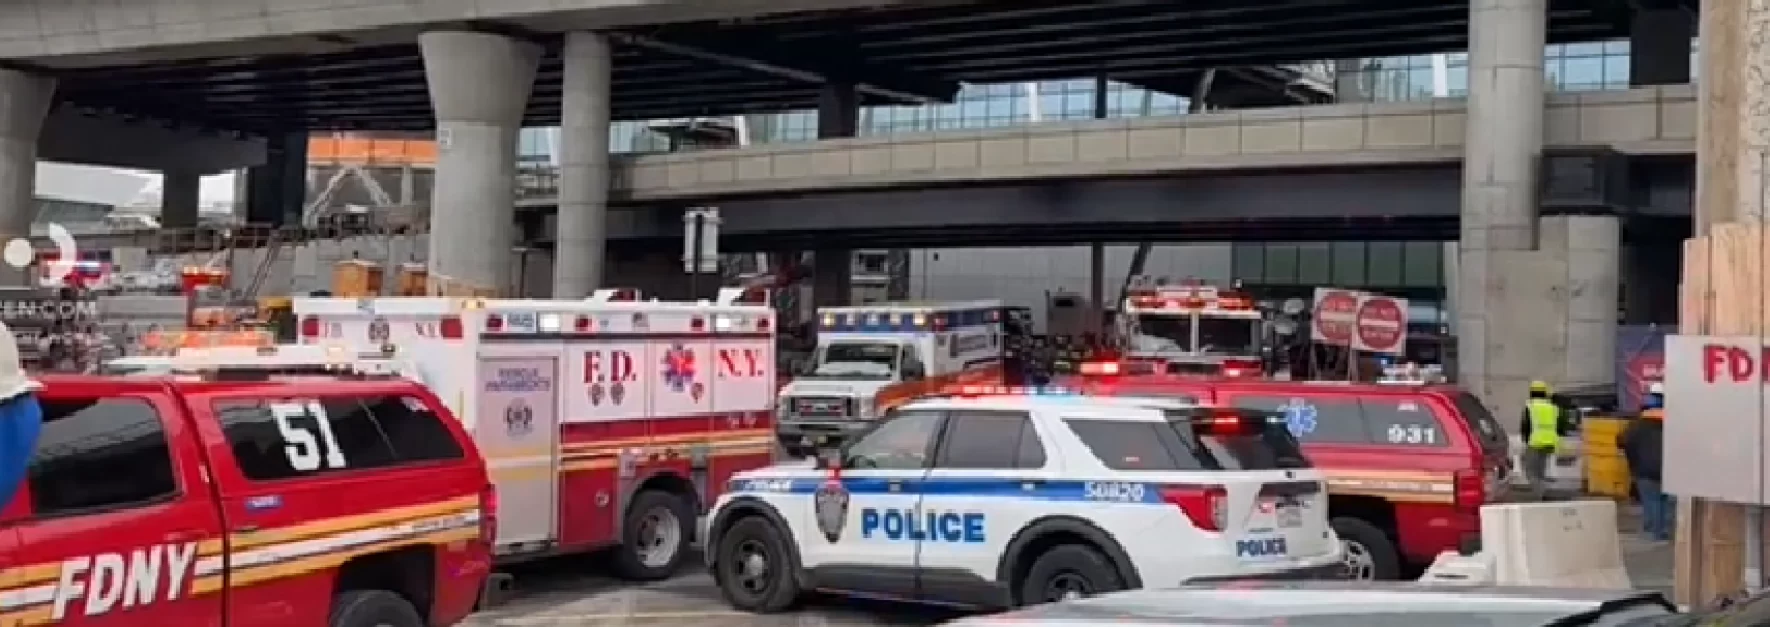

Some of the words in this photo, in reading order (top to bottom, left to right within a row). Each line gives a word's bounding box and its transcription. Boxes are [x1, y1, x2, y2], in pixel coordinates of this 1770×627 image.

[271, 399, 346, 470] 51
[1387, 424, 1435, 444] 931
[861, 508, 985, 542] POLICE
[1236, 537, 1287, 557] POLICE
[51, 541, 197, 620] FDNY
